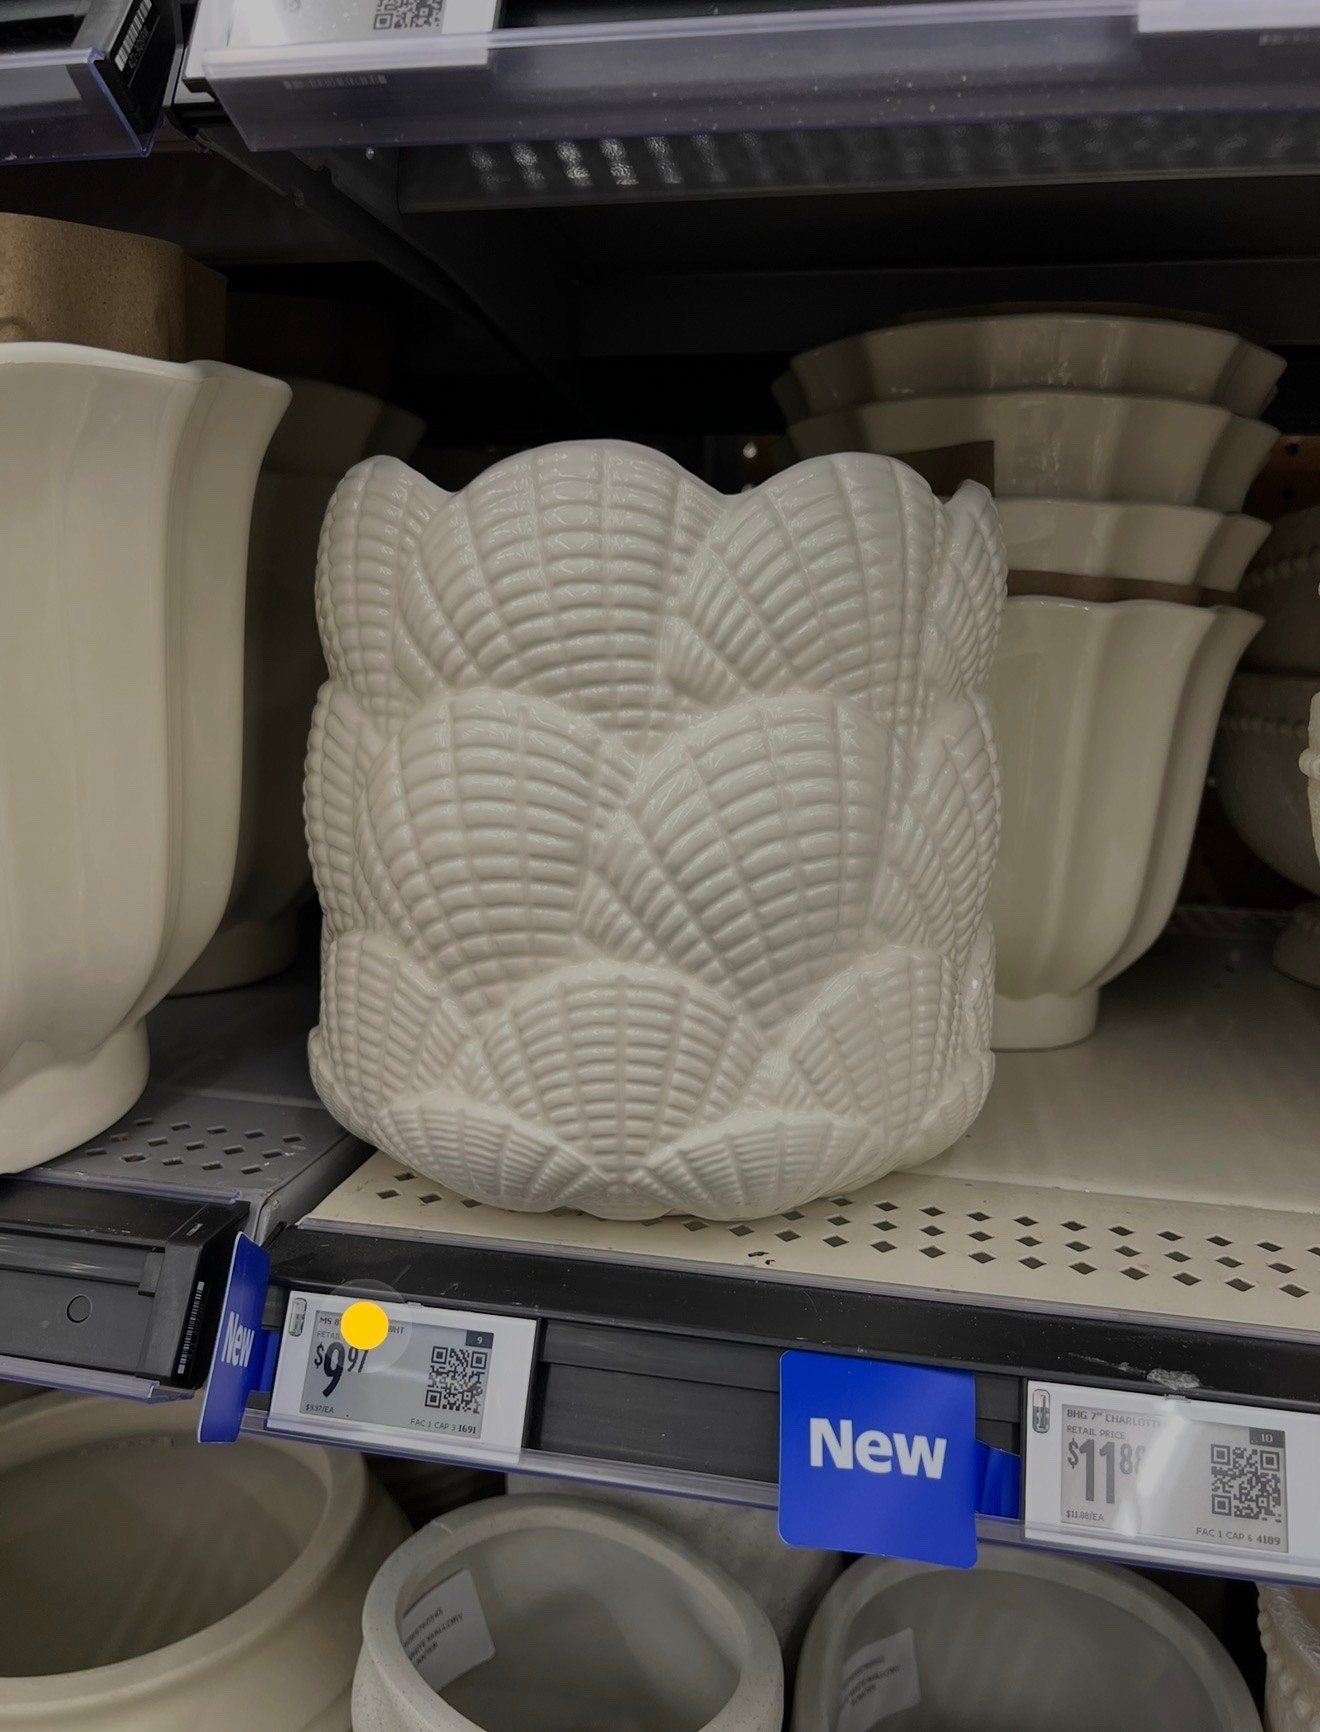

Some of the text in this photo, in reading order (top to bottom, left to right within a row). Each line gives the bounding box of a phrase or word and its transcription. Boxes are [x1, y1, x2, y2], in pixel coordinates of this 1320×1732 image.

[320, 1316, 332, 1325] MS
[221, 1311, 255, 1368] New
[477, 1336, 483, 1345] 9
[1067, 1409, 1087, 1420] BHG
[410, 1418, 426, 1427] FAC
[434, 1421, 449, 1430] CAP
[458, 1425, 476, 1434] 1691
[1066, 1425, 1125, 1440] RETAIL PRICE
[1261, 1433, 1273, 1443] 10
[810, 1418, 947, 1480] New
[1066, 1510, 1104, 1521] $11.88/EA
[1196, 1527, 1215, 1537] FAC
[1226, 1532, 1244, 1540] CAP
[1257, 1535, 1280, 1545] 4189
